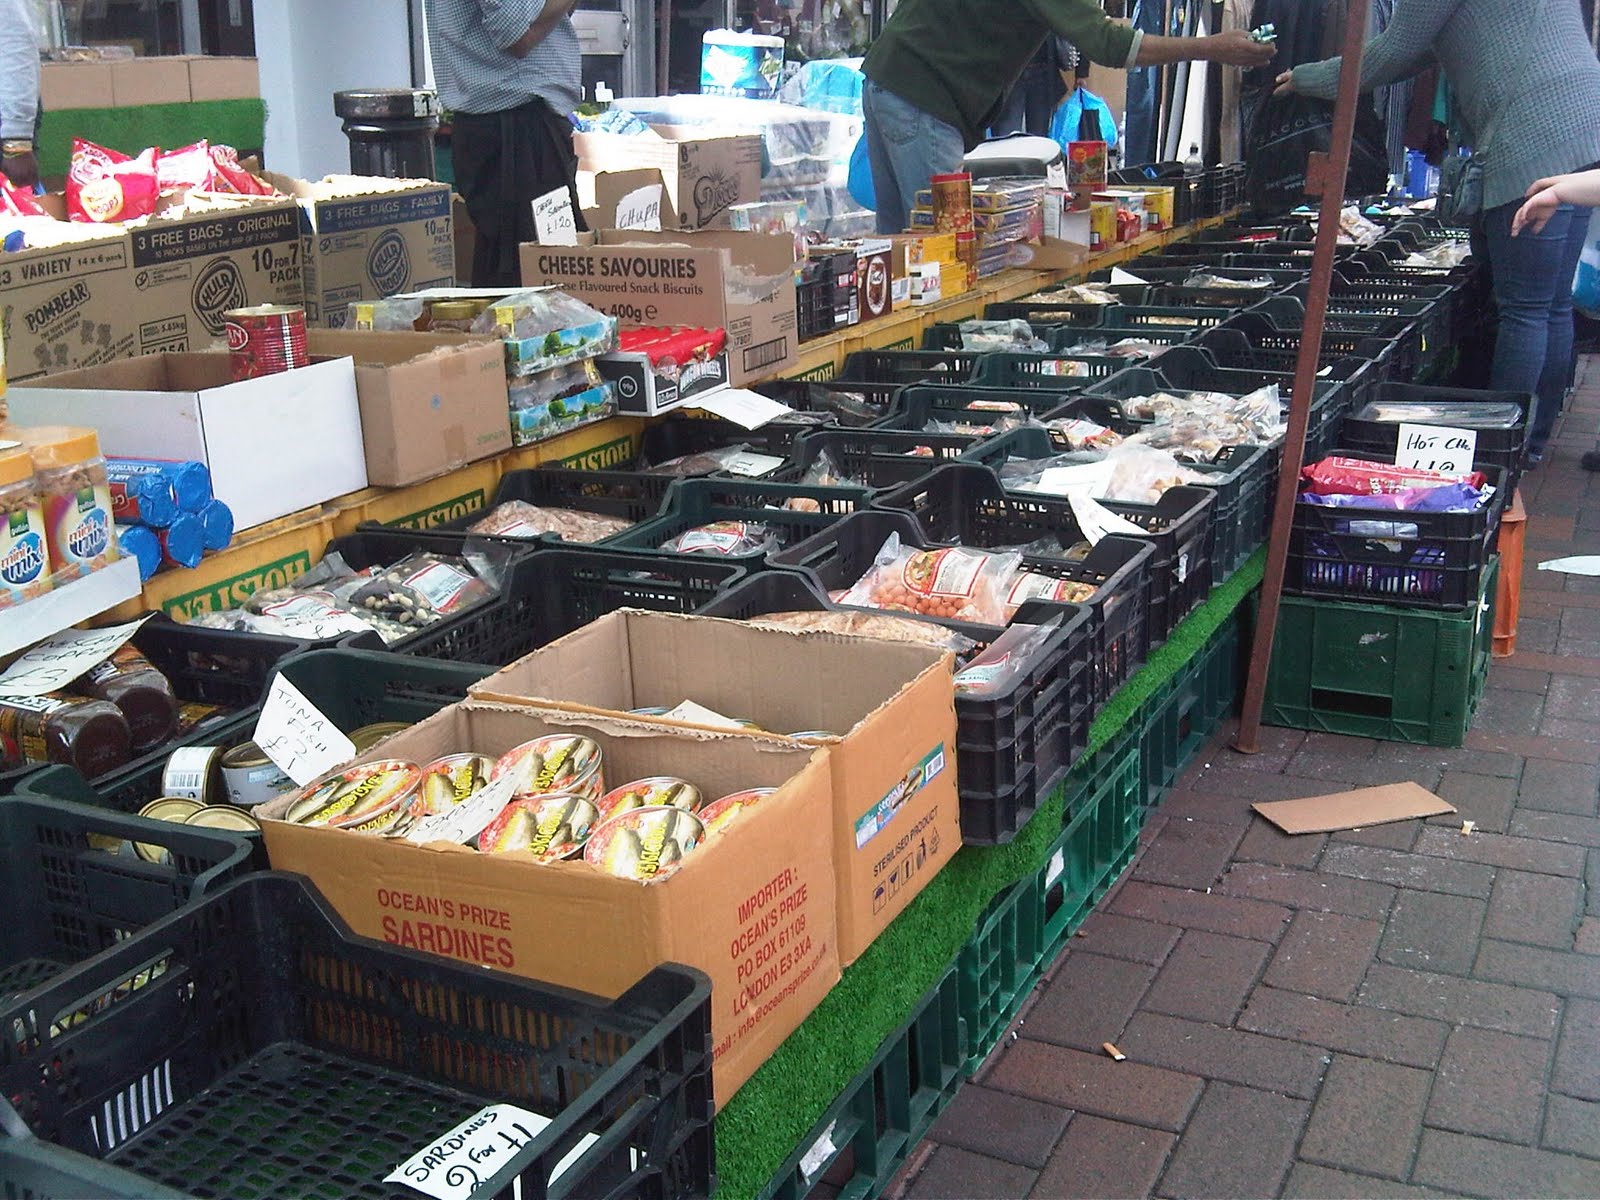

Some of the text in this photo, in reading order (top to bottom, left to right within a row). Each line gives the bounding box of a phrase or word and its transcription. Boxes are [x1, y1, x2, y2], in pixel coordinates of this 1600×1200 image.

[325, 210, 332, 221] 3
[338, 204, 366, 220] FREE
[371, 200, 400, 214] BAGS
[411, 194, 444, 209] FAMILY
[138, 237, 146, 250] 3
[151, 232, 184, 248] FREE
[188, 224, 224, 241] BAGS
[237, 213, 292, 233] ORIGINAL
[425, 219, 436, 236] 10
[21, 257, 72, 280] VARIETY
[252, 247, 273, 272] 10
[274, 256, 289, 269] FOR
[375, 244, 400, 273] HULA
[539, 255, 696, 279] CHEESE SAVOURIES
[201, 273, 231, 306] HULA
[270, 267, 301, 284] PACK
[579, 279, 627, 293] Flavoured
[630, 281, 660, 294] Snack
[663, 282, 703, 296] Biscuits
[611, 303, 642, 323] 400g
[69, 518, 94, 543] mini
[1, 544, 27, 569] mini
[873, 805, 939, 878] STERILISED PRODUCT
[378, 888, 512, 931] OCEAN'S PRIZE
[738, 867, 792, 925] IMPORTER
[731, 883, 809, 960] OCEAN'S PRIZE
[382, 914, 515, 969] SARDINES
[737, 914, 806, 984] PO BOX 61109
[779, 952, 793, 978] E3
[794, 935, 812, 966] 3XA
